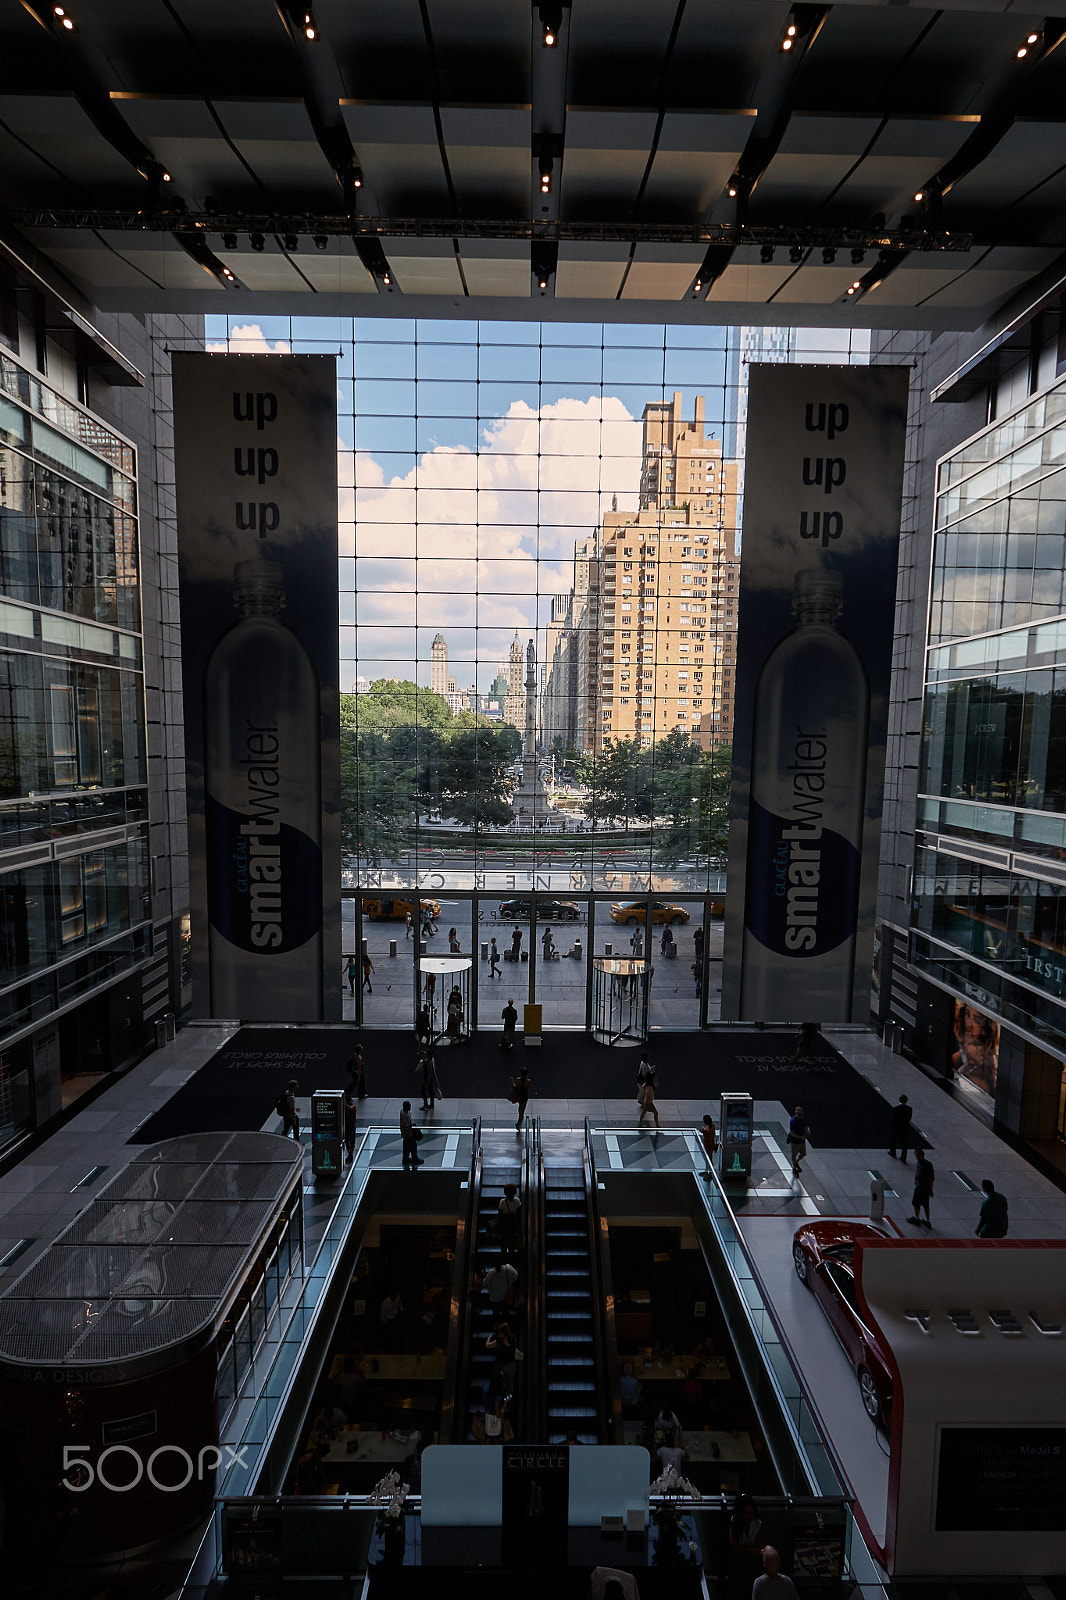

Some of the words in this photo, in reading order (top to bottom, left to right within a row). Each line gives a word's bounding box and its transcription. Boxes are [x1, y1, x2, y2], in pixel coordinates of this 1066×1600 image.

[233, 392, 277, 429] up
[805, 401, 849, 439] up
[234, 446, 279, 483] up
[802, 456, 846, 493] up
[236, 500, 280, 538] up
[799, 510, 843, 547] up
[239, 718, 283, 947] smartwater
[780, 724, 826, 953] smartwater
[220, 1051, 264, 1060] CIRCLE
[224, 1060, 246, 1070] AT
[245, 1060, 284, 1070] SHOPS
[263, 1051, 328, 1061] COLUMBUS
[284, 1060, 308, 1070] THE
